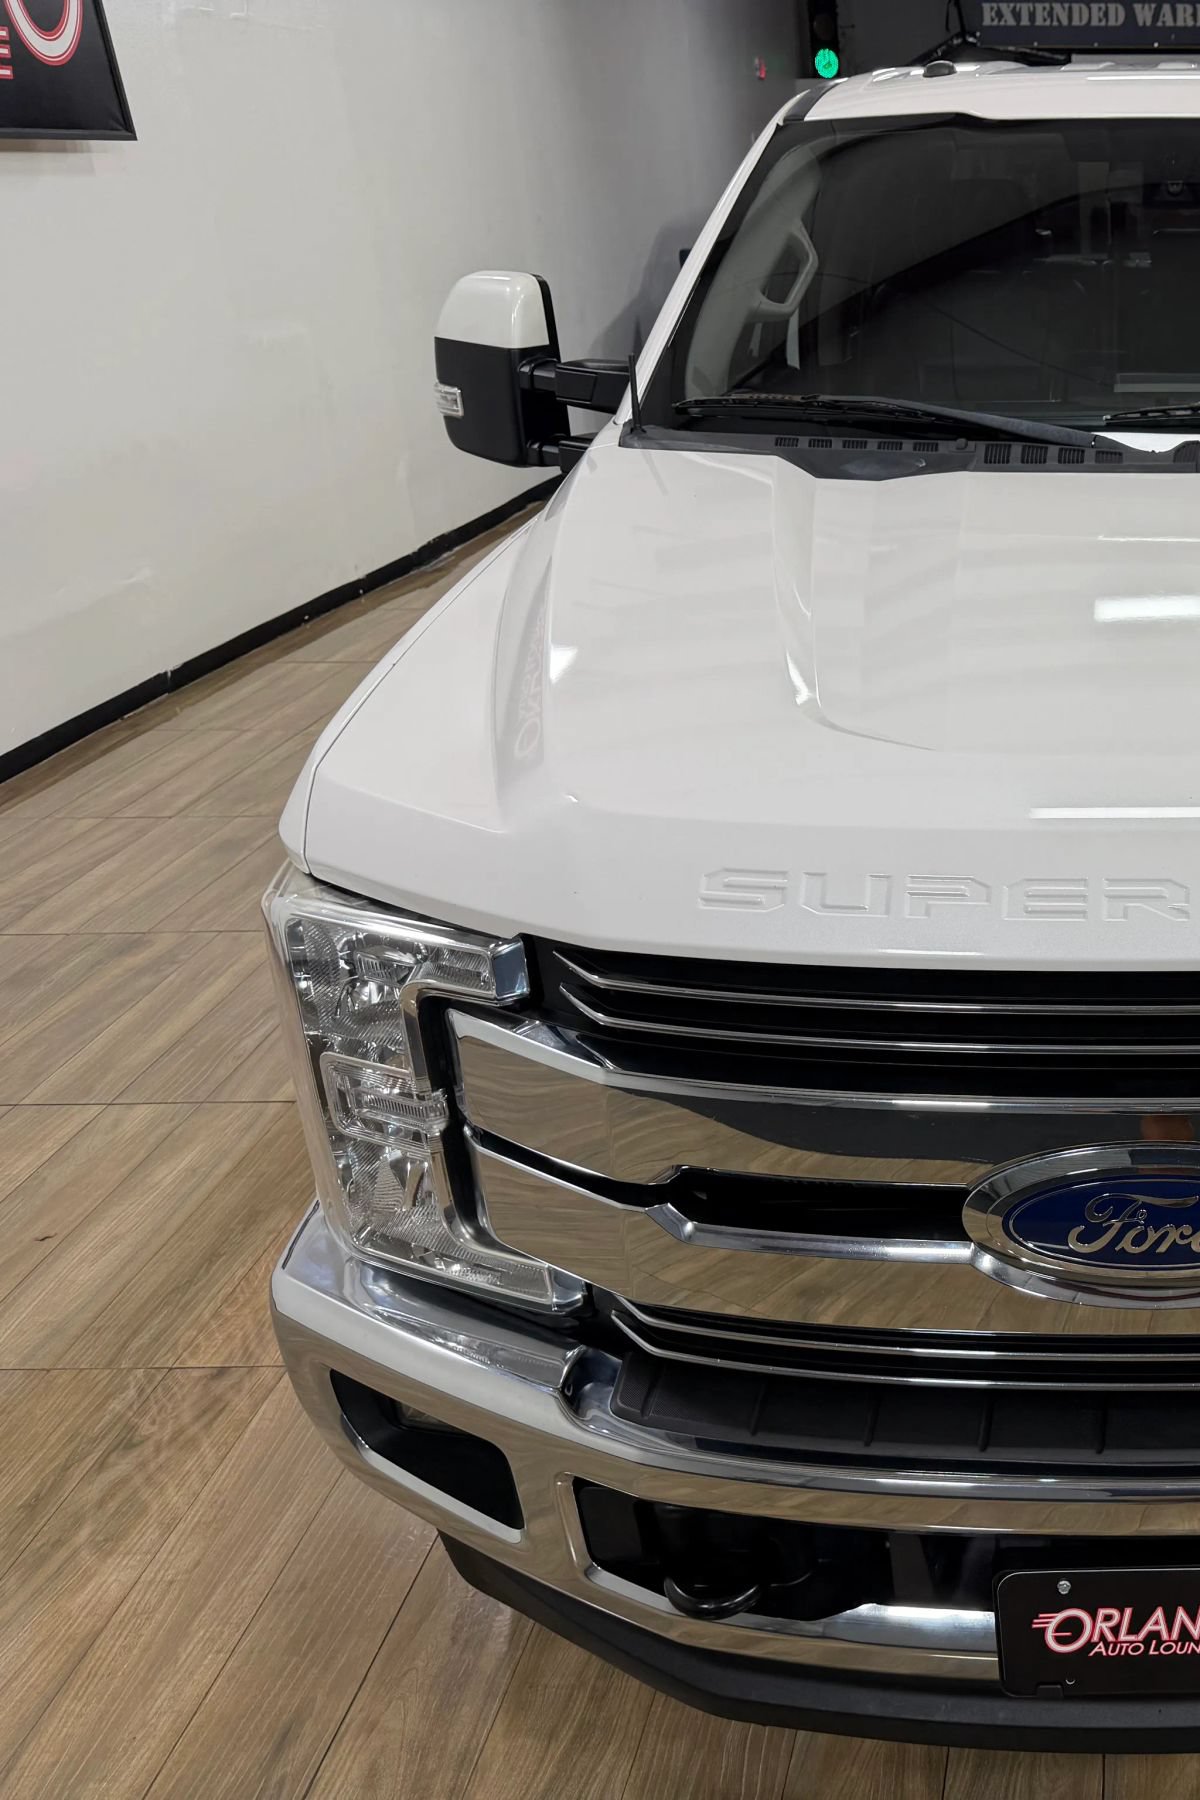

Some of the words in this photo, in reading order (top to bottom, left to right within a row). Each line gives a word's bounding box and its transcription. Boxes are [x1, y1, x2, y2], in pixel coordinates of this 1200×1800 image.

[981, 2, 1126, 27] EXTENDED
[699, 867, 1191, 922] SUPER
[1088, 1641, 1145, 1657] AUTO
